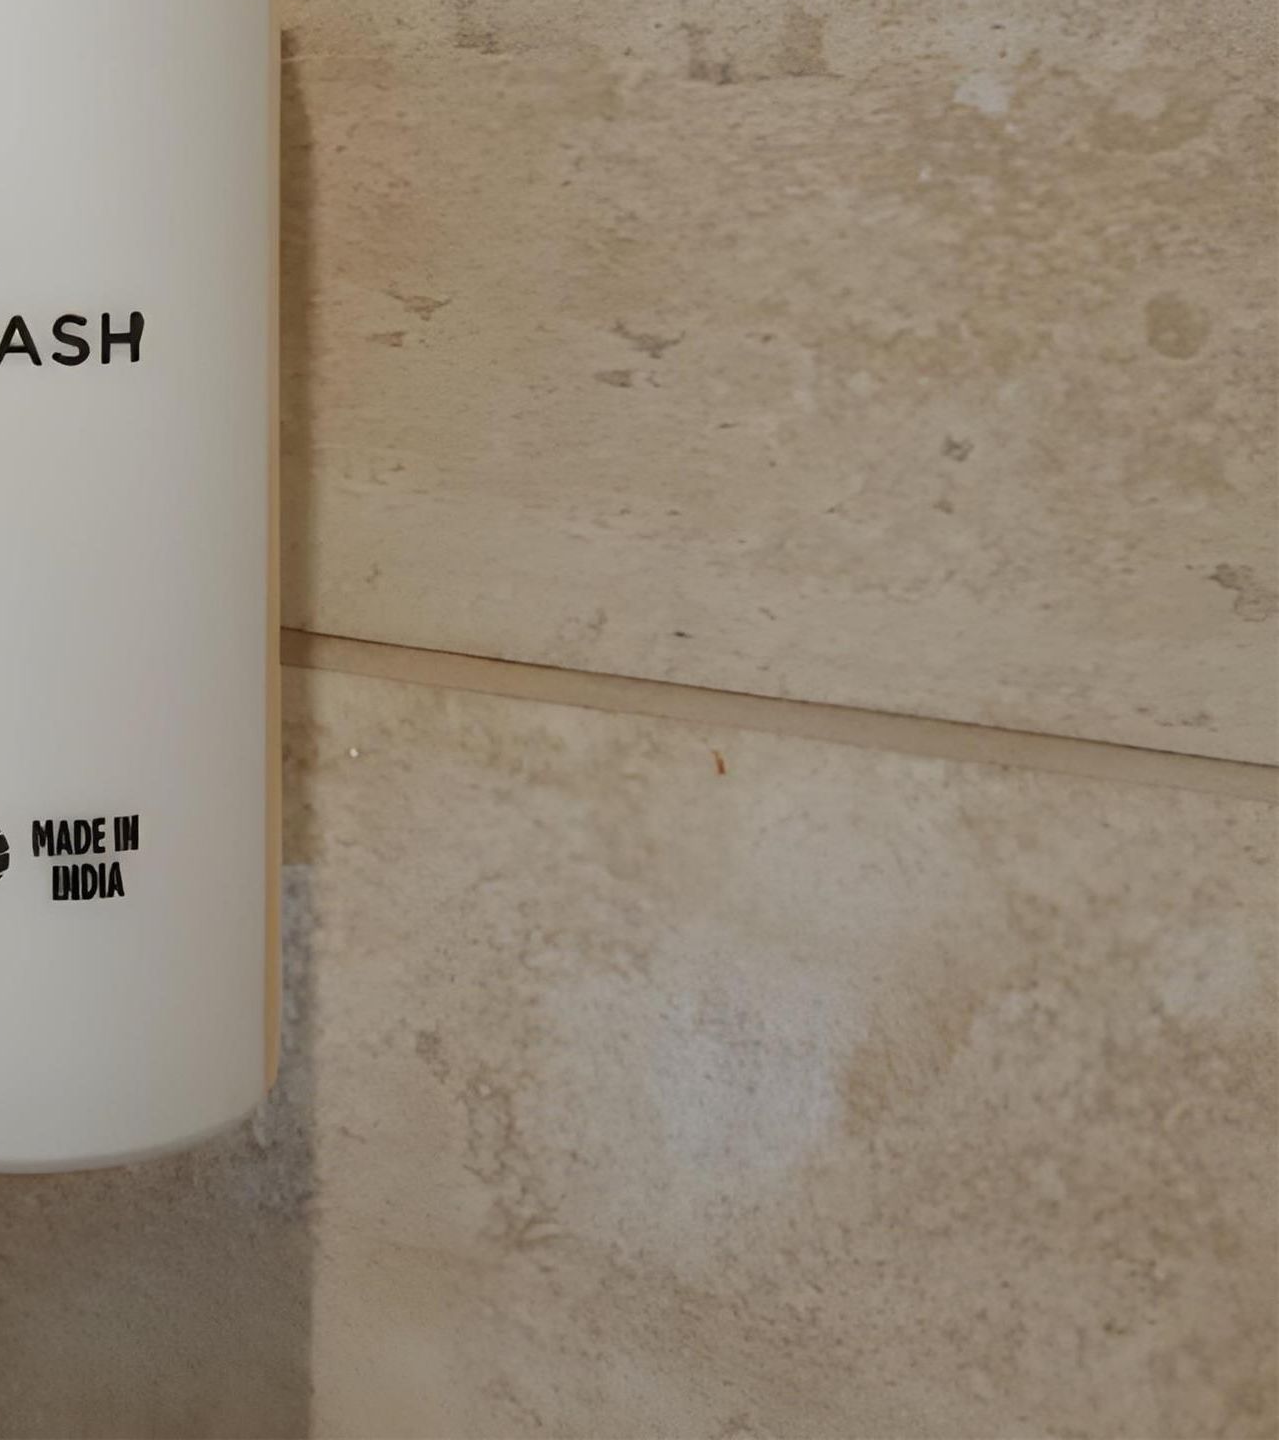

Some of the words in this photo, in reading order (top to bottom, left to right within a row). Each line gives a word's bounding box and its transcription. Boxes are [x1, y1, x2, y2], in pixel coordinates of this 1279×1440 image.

[32, 818, 105, 857] MADE
[114, 815, 139, 852] IN
[52, 862, 124, 901] INDIA
